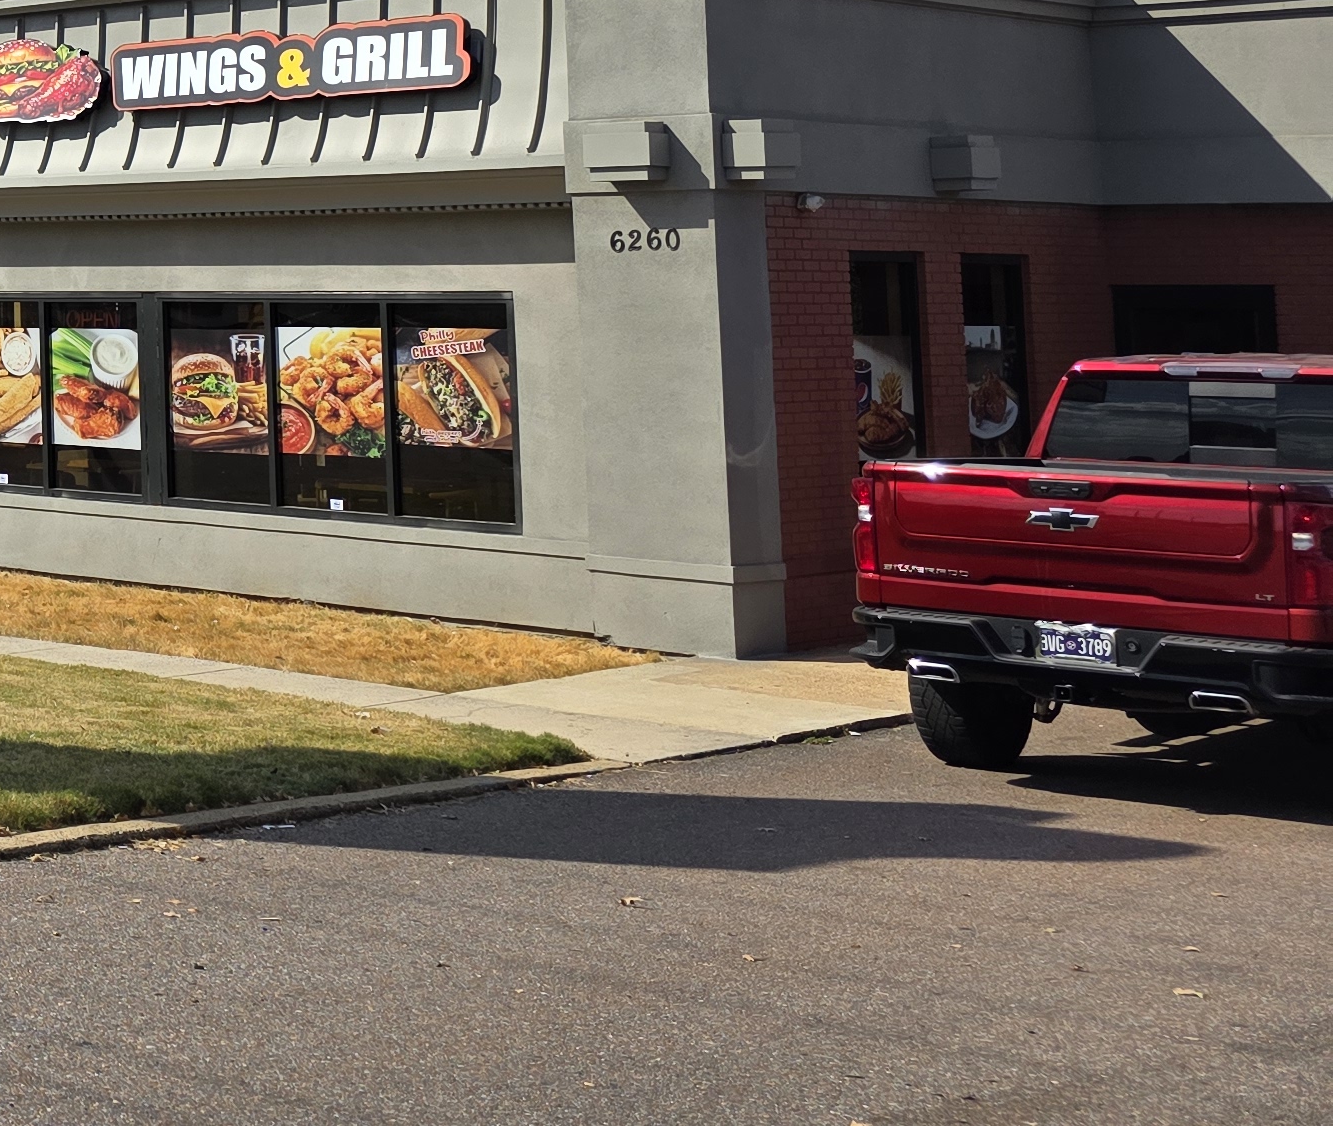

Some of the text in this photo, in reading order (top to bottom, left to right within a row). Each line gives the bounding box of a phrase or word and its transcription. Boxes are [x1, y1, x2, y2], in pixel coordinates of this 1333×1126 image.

[121, 28, 454, 101] WINGS & GRILL
[609, 227, 681, 253] 6260
[420, 330, 454, 342] Philly
[412, 340, 486, 358] CHEESESTEAK
[1255, 593, 1275, 601] LT
[1077, 638, 1112, 657] 3789
